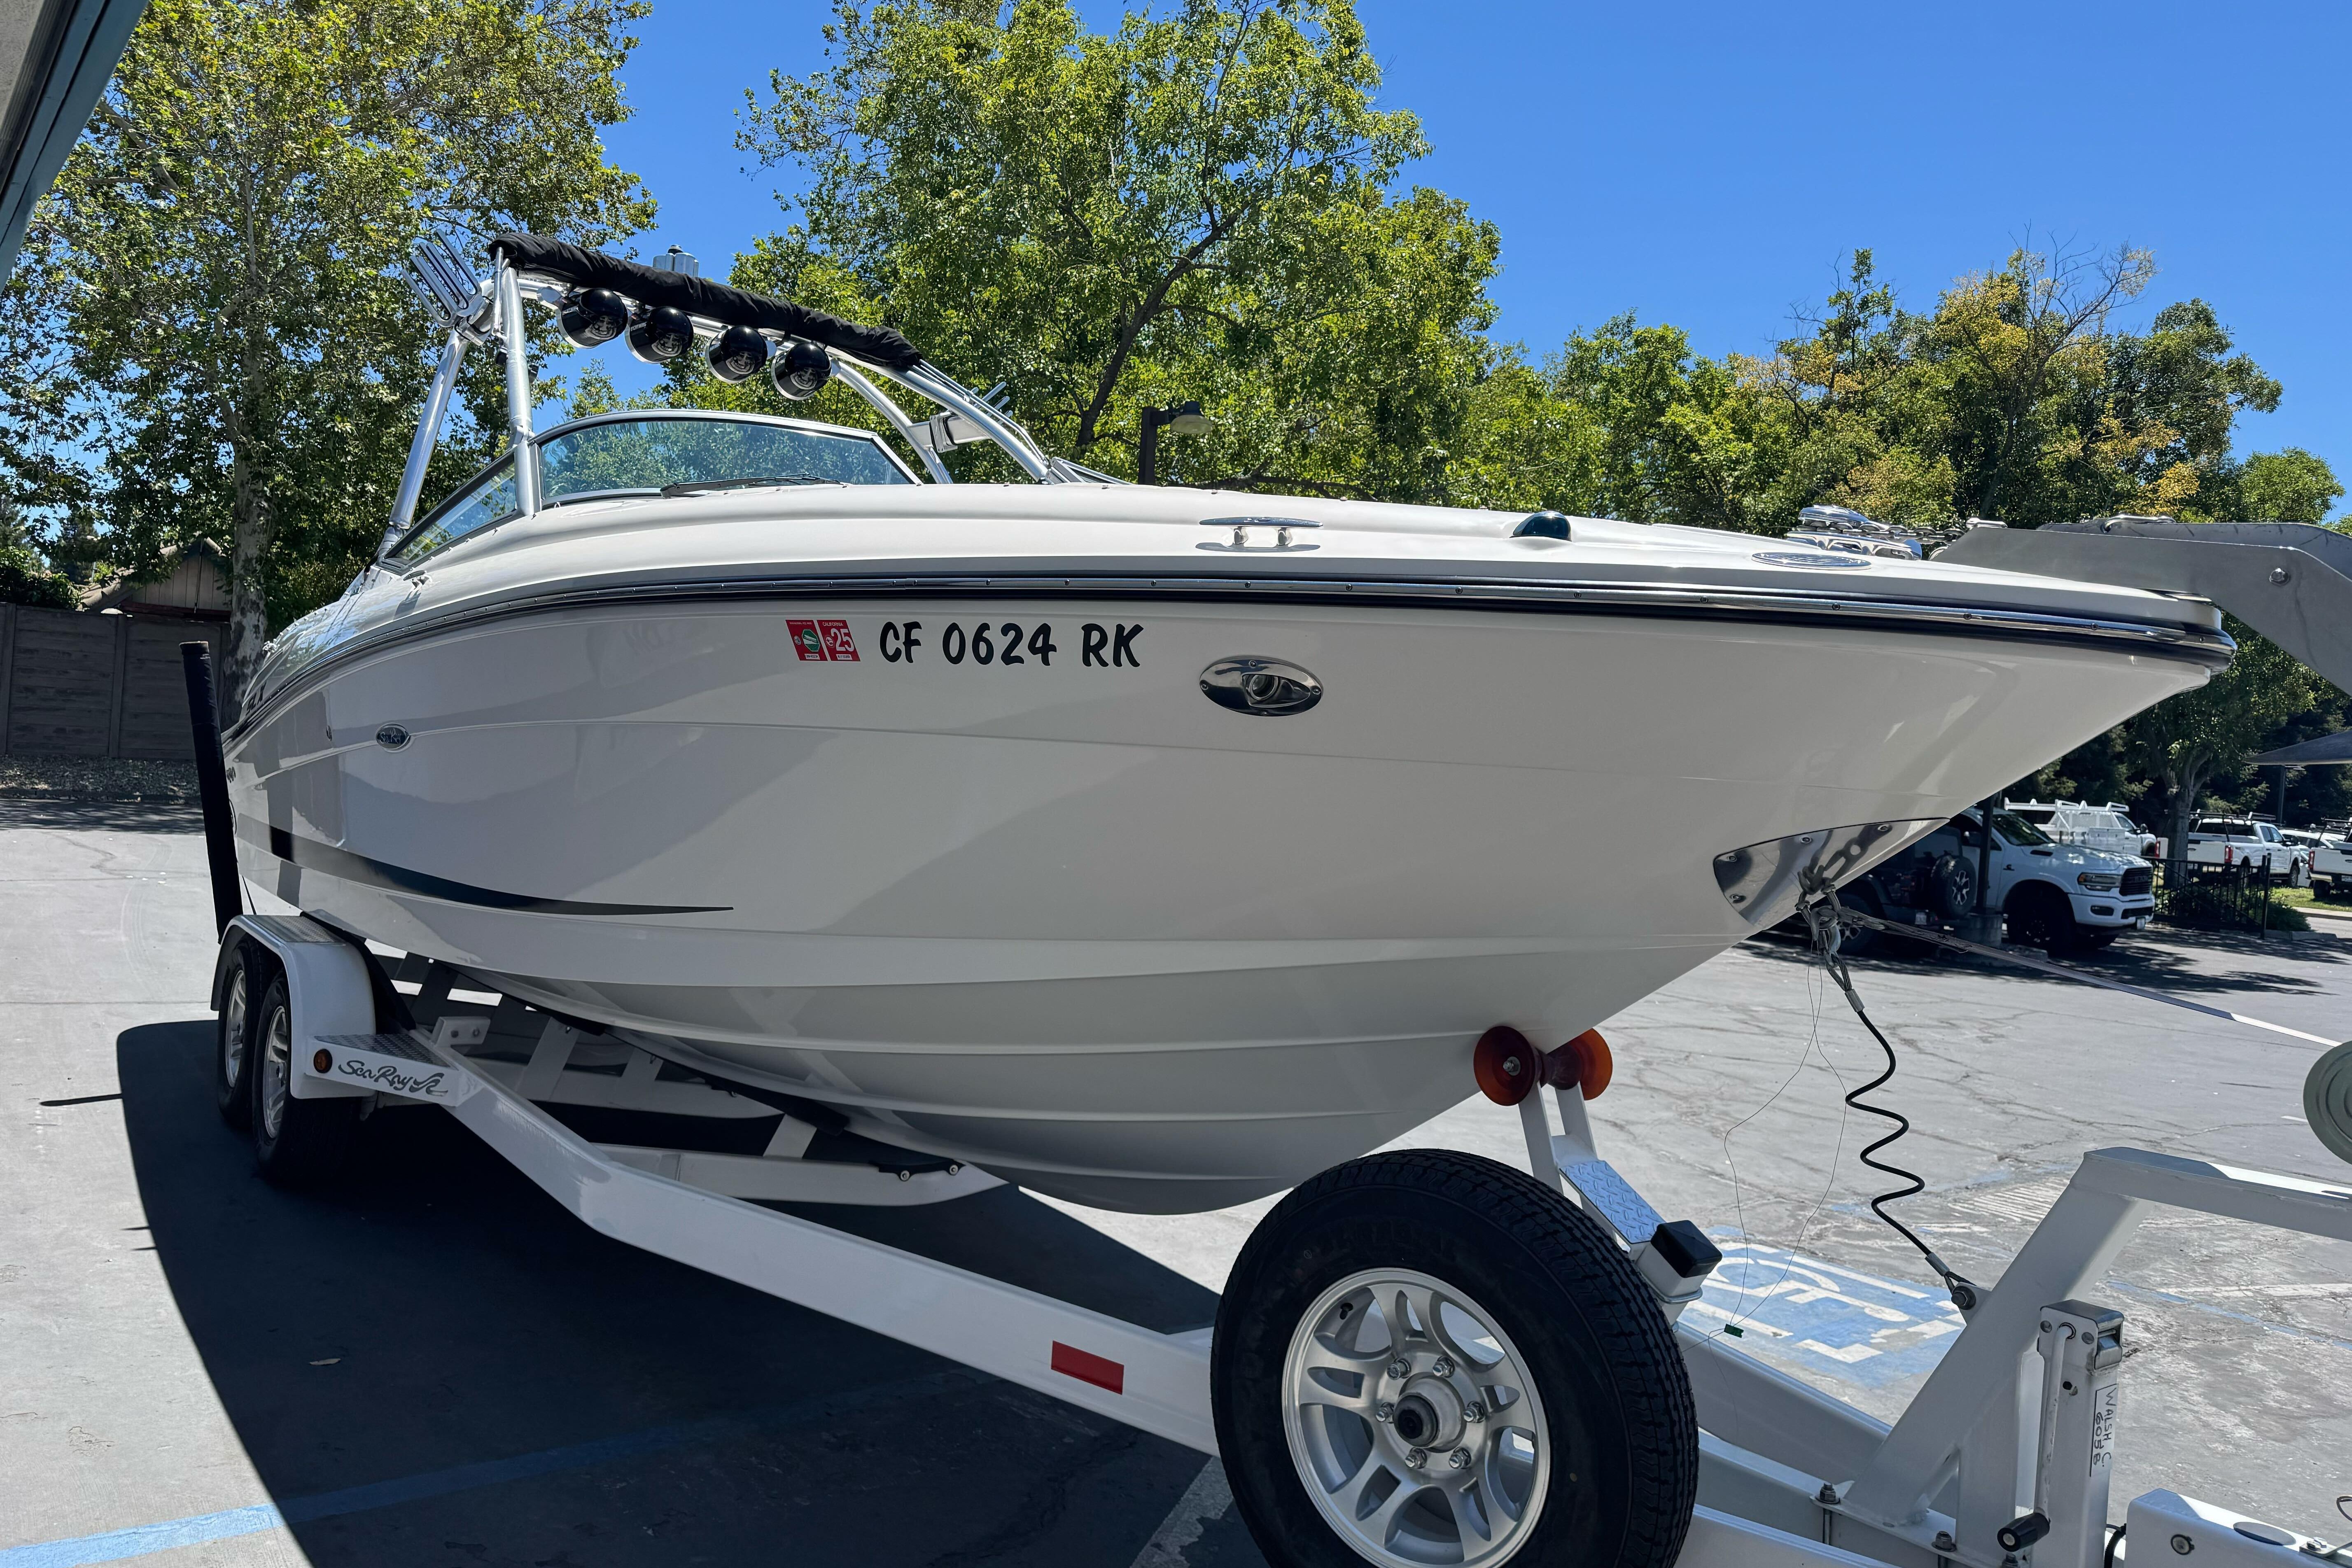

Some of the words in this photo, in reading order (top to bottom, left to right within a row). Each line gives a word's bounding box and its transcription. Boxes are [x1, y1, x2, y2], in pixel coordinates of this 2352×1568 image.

[831, 628, 854, 651] 25
[880, 621, 922, 663] CF
[943, 622, 1057, 665] 0624
[1081, 623, 1144, 667] RK
[2104, 1388, 2116, 1441] WALSH
[2101, 1452, 2112, 1468] C.
